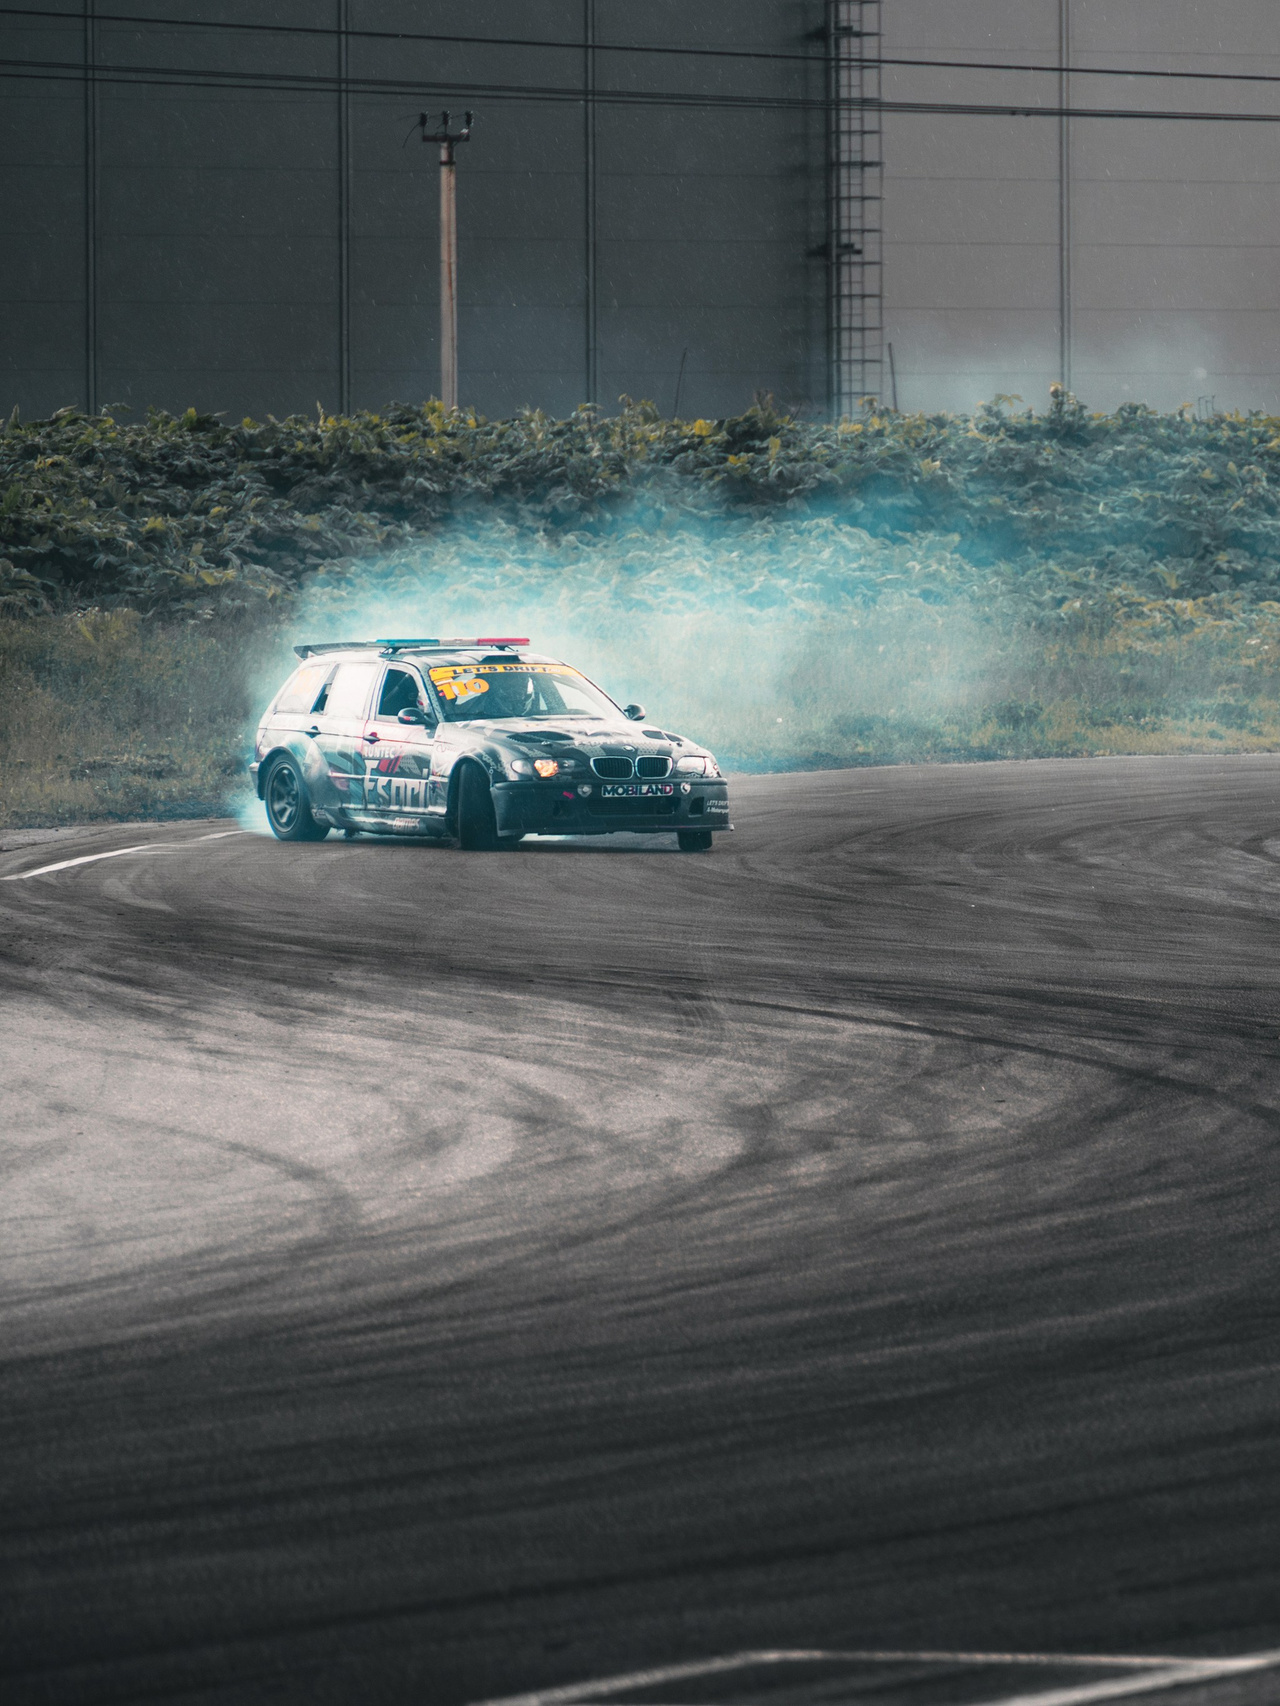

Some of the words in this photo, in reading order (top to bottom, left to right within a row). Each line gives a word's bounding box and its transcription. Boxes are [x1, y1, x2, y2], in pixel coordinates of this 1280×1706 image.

[452, 666, 498, 675] LET'S
[502, 665, 548, 673] DRIFT
[437, 678, 489, 700] 110
[602, 784, 673, 796] MOBILAND
